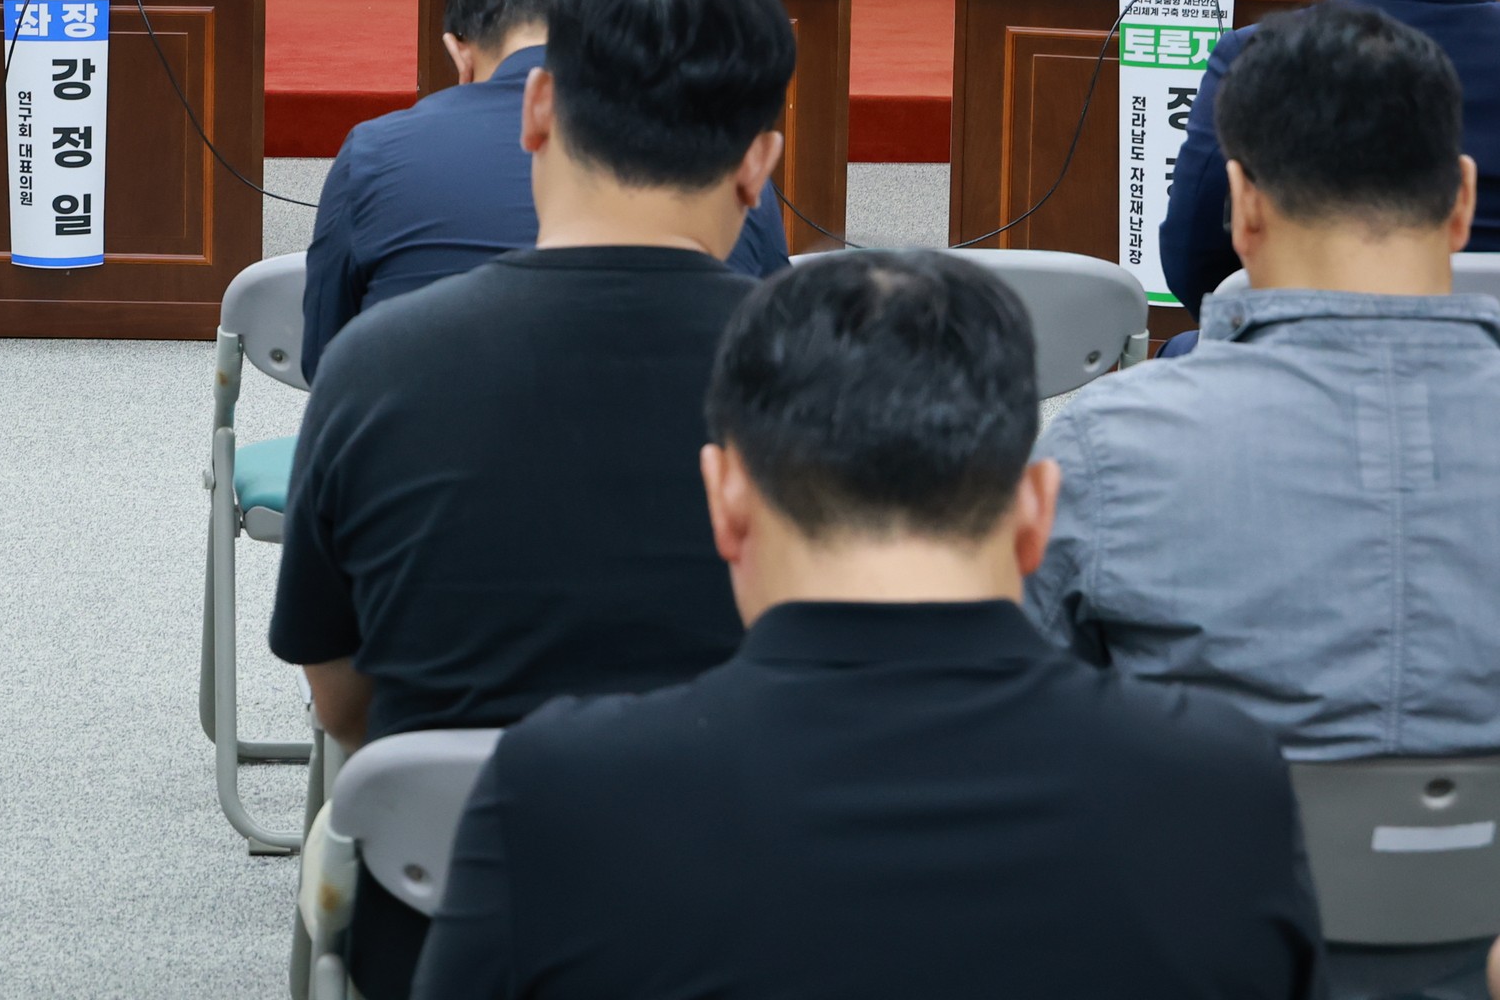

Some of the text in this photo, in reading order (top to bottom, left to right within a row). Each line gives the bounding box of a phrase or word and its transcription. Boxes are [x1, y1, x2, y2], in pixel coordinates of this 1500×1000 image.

[1162, 8, 1178, 17] 구축
[1182, 9, 1199, 18] 방안
[18, 91, 32, 206] 연구회 대표의원
[52, 58, 95, 235] 강정일
[1130, 96, 1146, 264] 전라남도 자연재난과장
